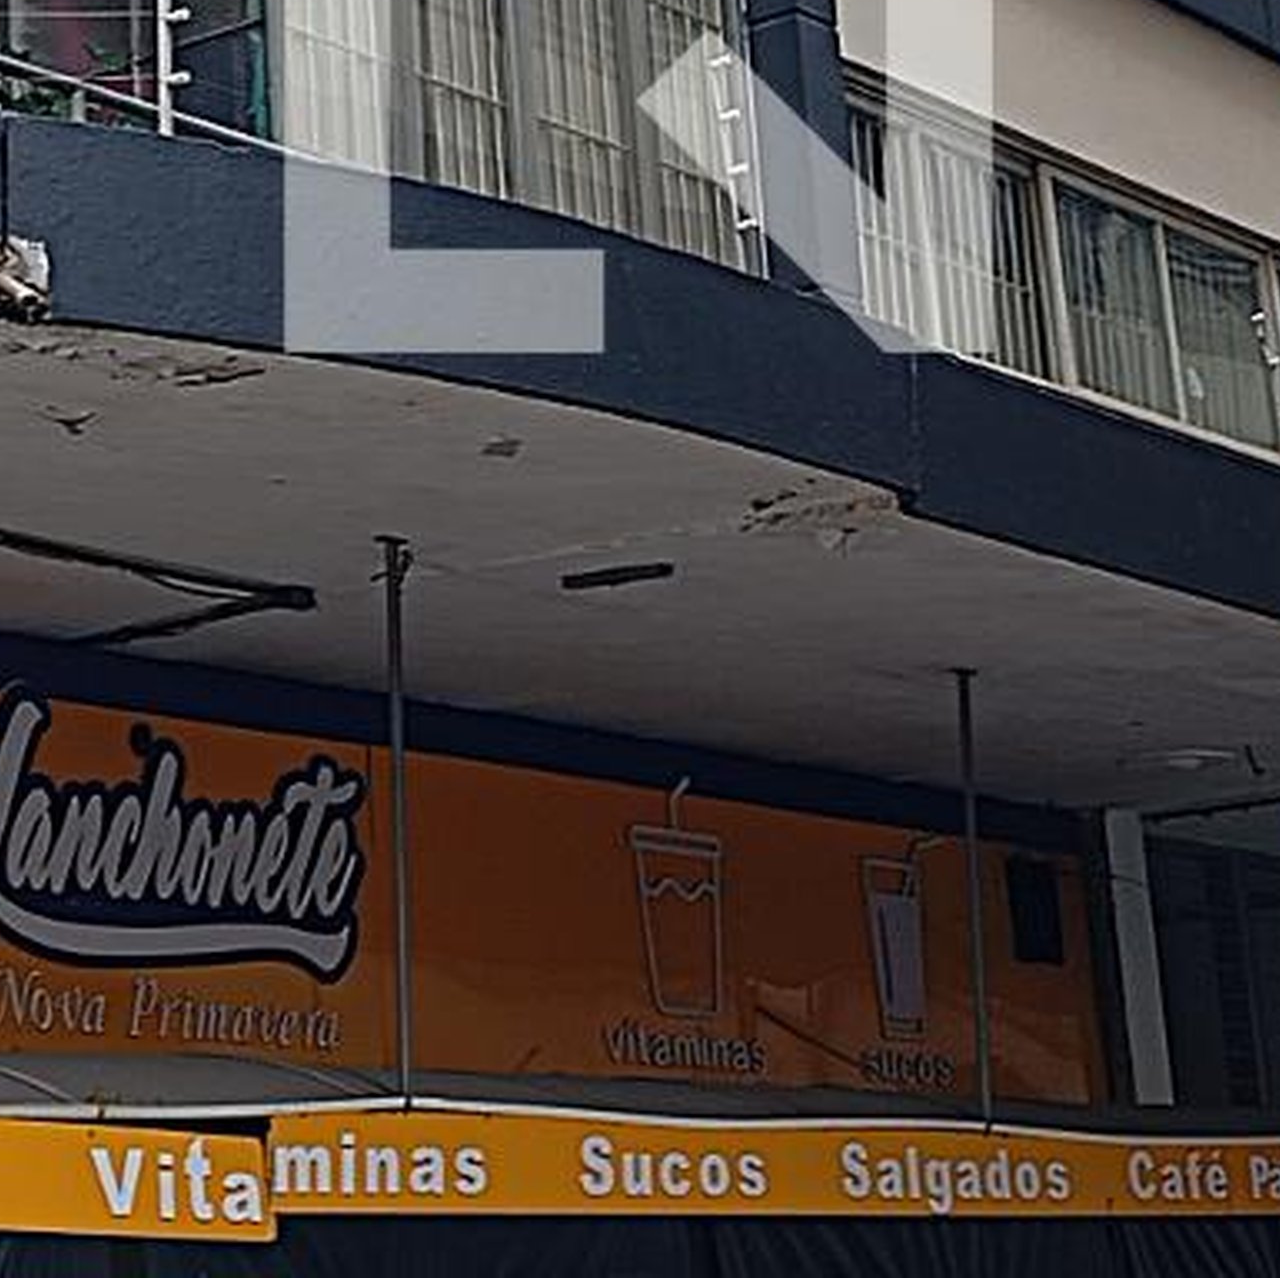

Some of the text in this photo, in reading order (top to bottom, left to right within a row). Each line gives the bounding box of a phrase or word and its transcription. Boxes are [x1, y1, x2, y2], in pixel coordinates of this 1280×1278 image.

[130, 975, 342, 1050] Primavera
[861, 1046, 956, 1088] sucos
[579, 1135, 768, 1200] Sucos
[840, 1139, 1073, 1216] Salgados
[1127, 1148, 1229, 1200] Café
